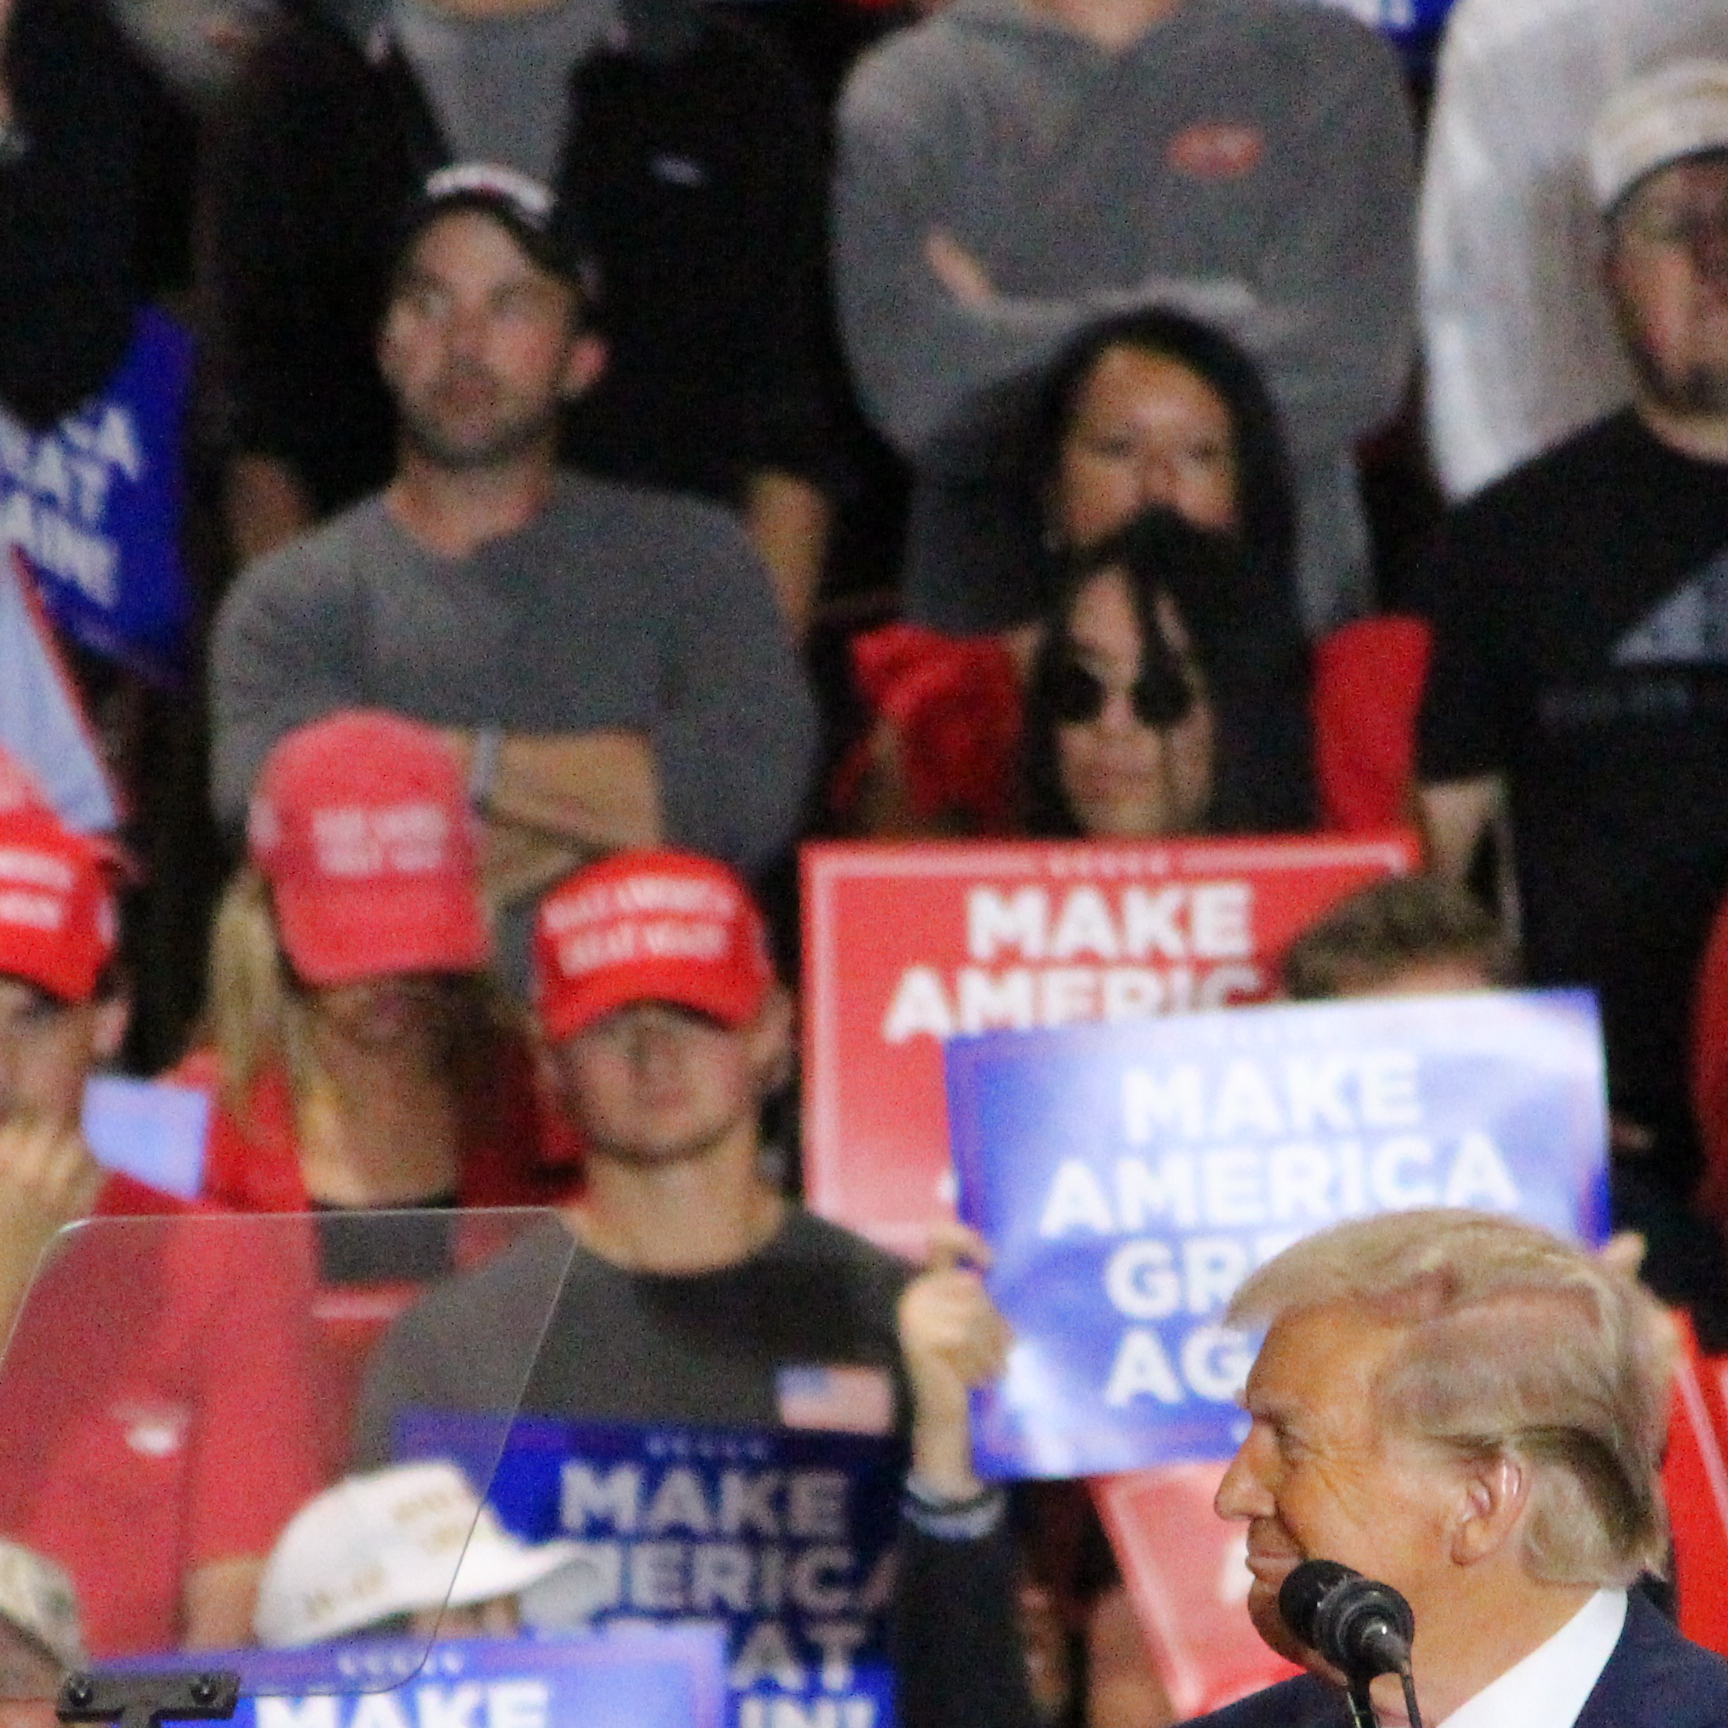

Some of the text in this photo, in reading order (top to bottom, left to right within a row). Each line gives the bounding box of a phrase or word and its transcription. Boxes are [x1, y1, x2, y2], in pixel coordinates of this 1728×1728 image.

[965, 882, 1255, 961] MAKE
[1122, 1053, 1422, 1144] MAKE
[1040, 1132, 1520, 1237] AMERICA
[559, 1460, 851, 1540] MAKE
